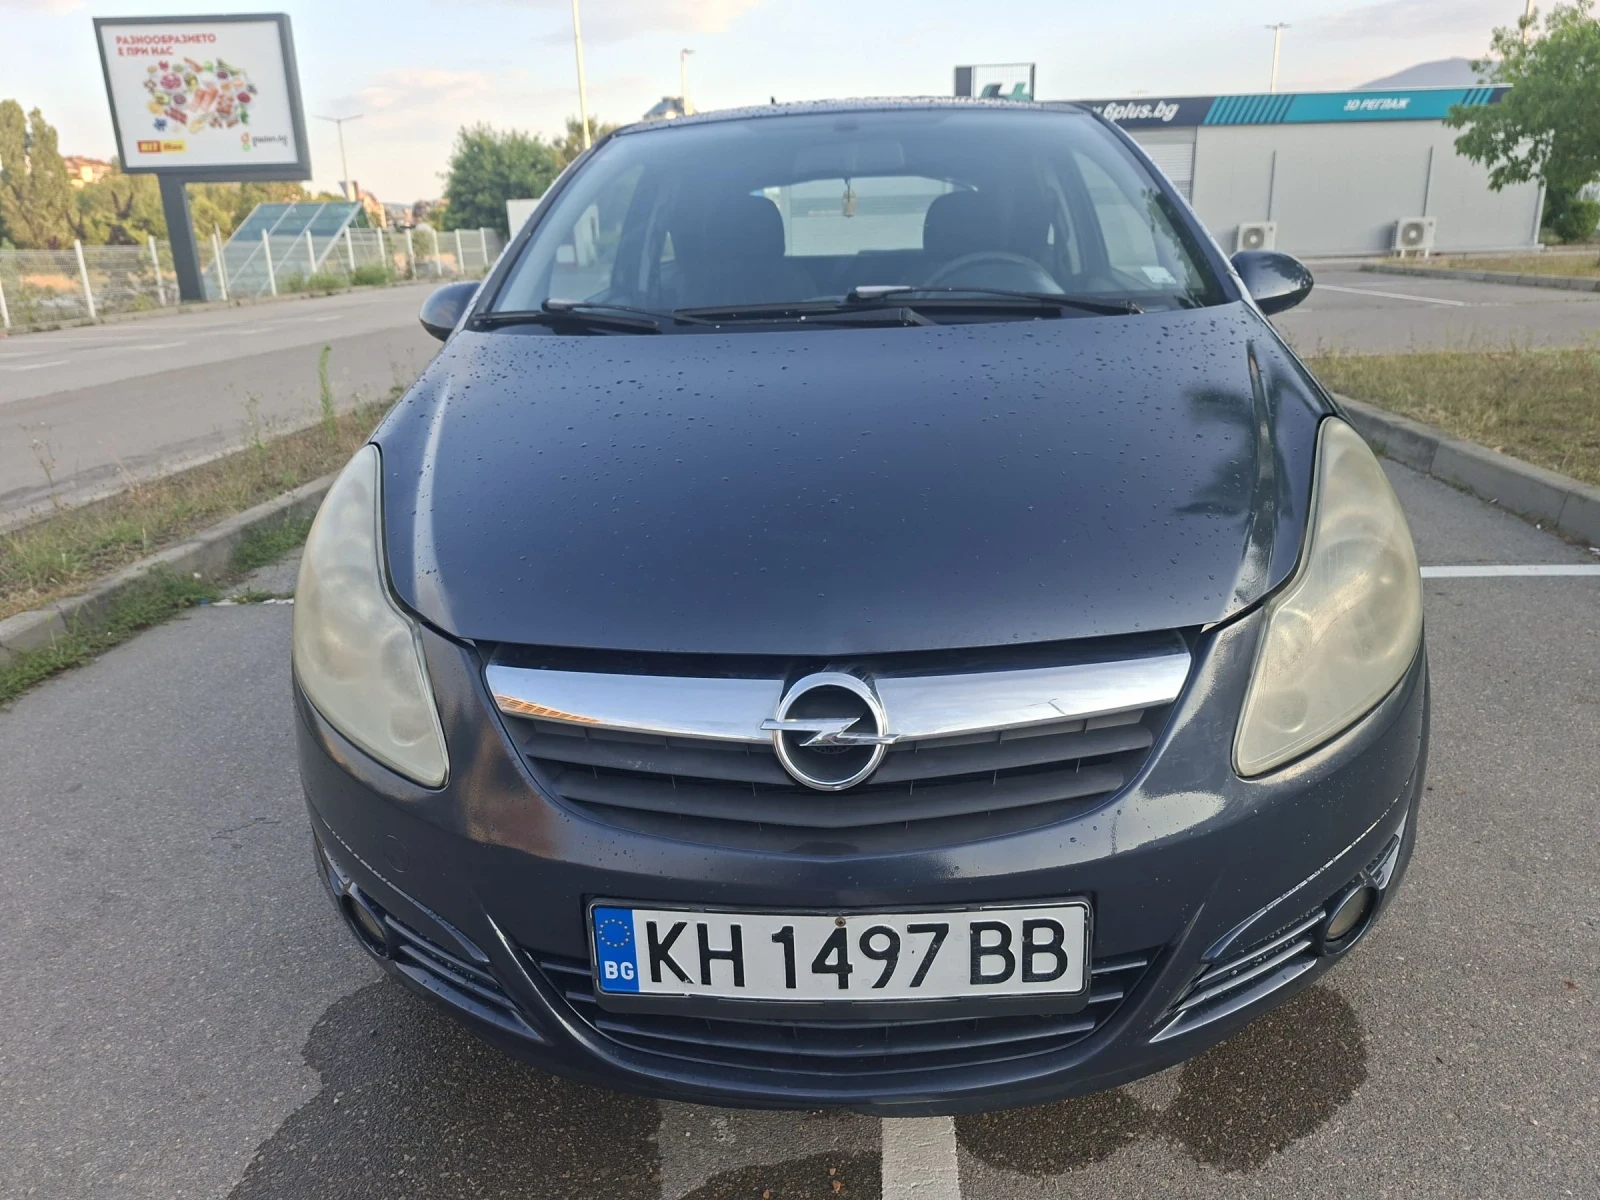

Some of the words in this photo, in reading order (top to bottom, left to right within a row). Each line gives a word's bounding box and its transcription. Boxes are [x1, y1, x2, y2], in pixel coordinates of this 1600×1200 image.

[126, 46, 149, 55] ПРИ
[151, 46, 174, 55] НАС
[646, 920, 745, 987] KH
[771, 922, 949, 990] 1497
[969, 919, 1068, 986] BB
[604, 960, 634, 980] BG
